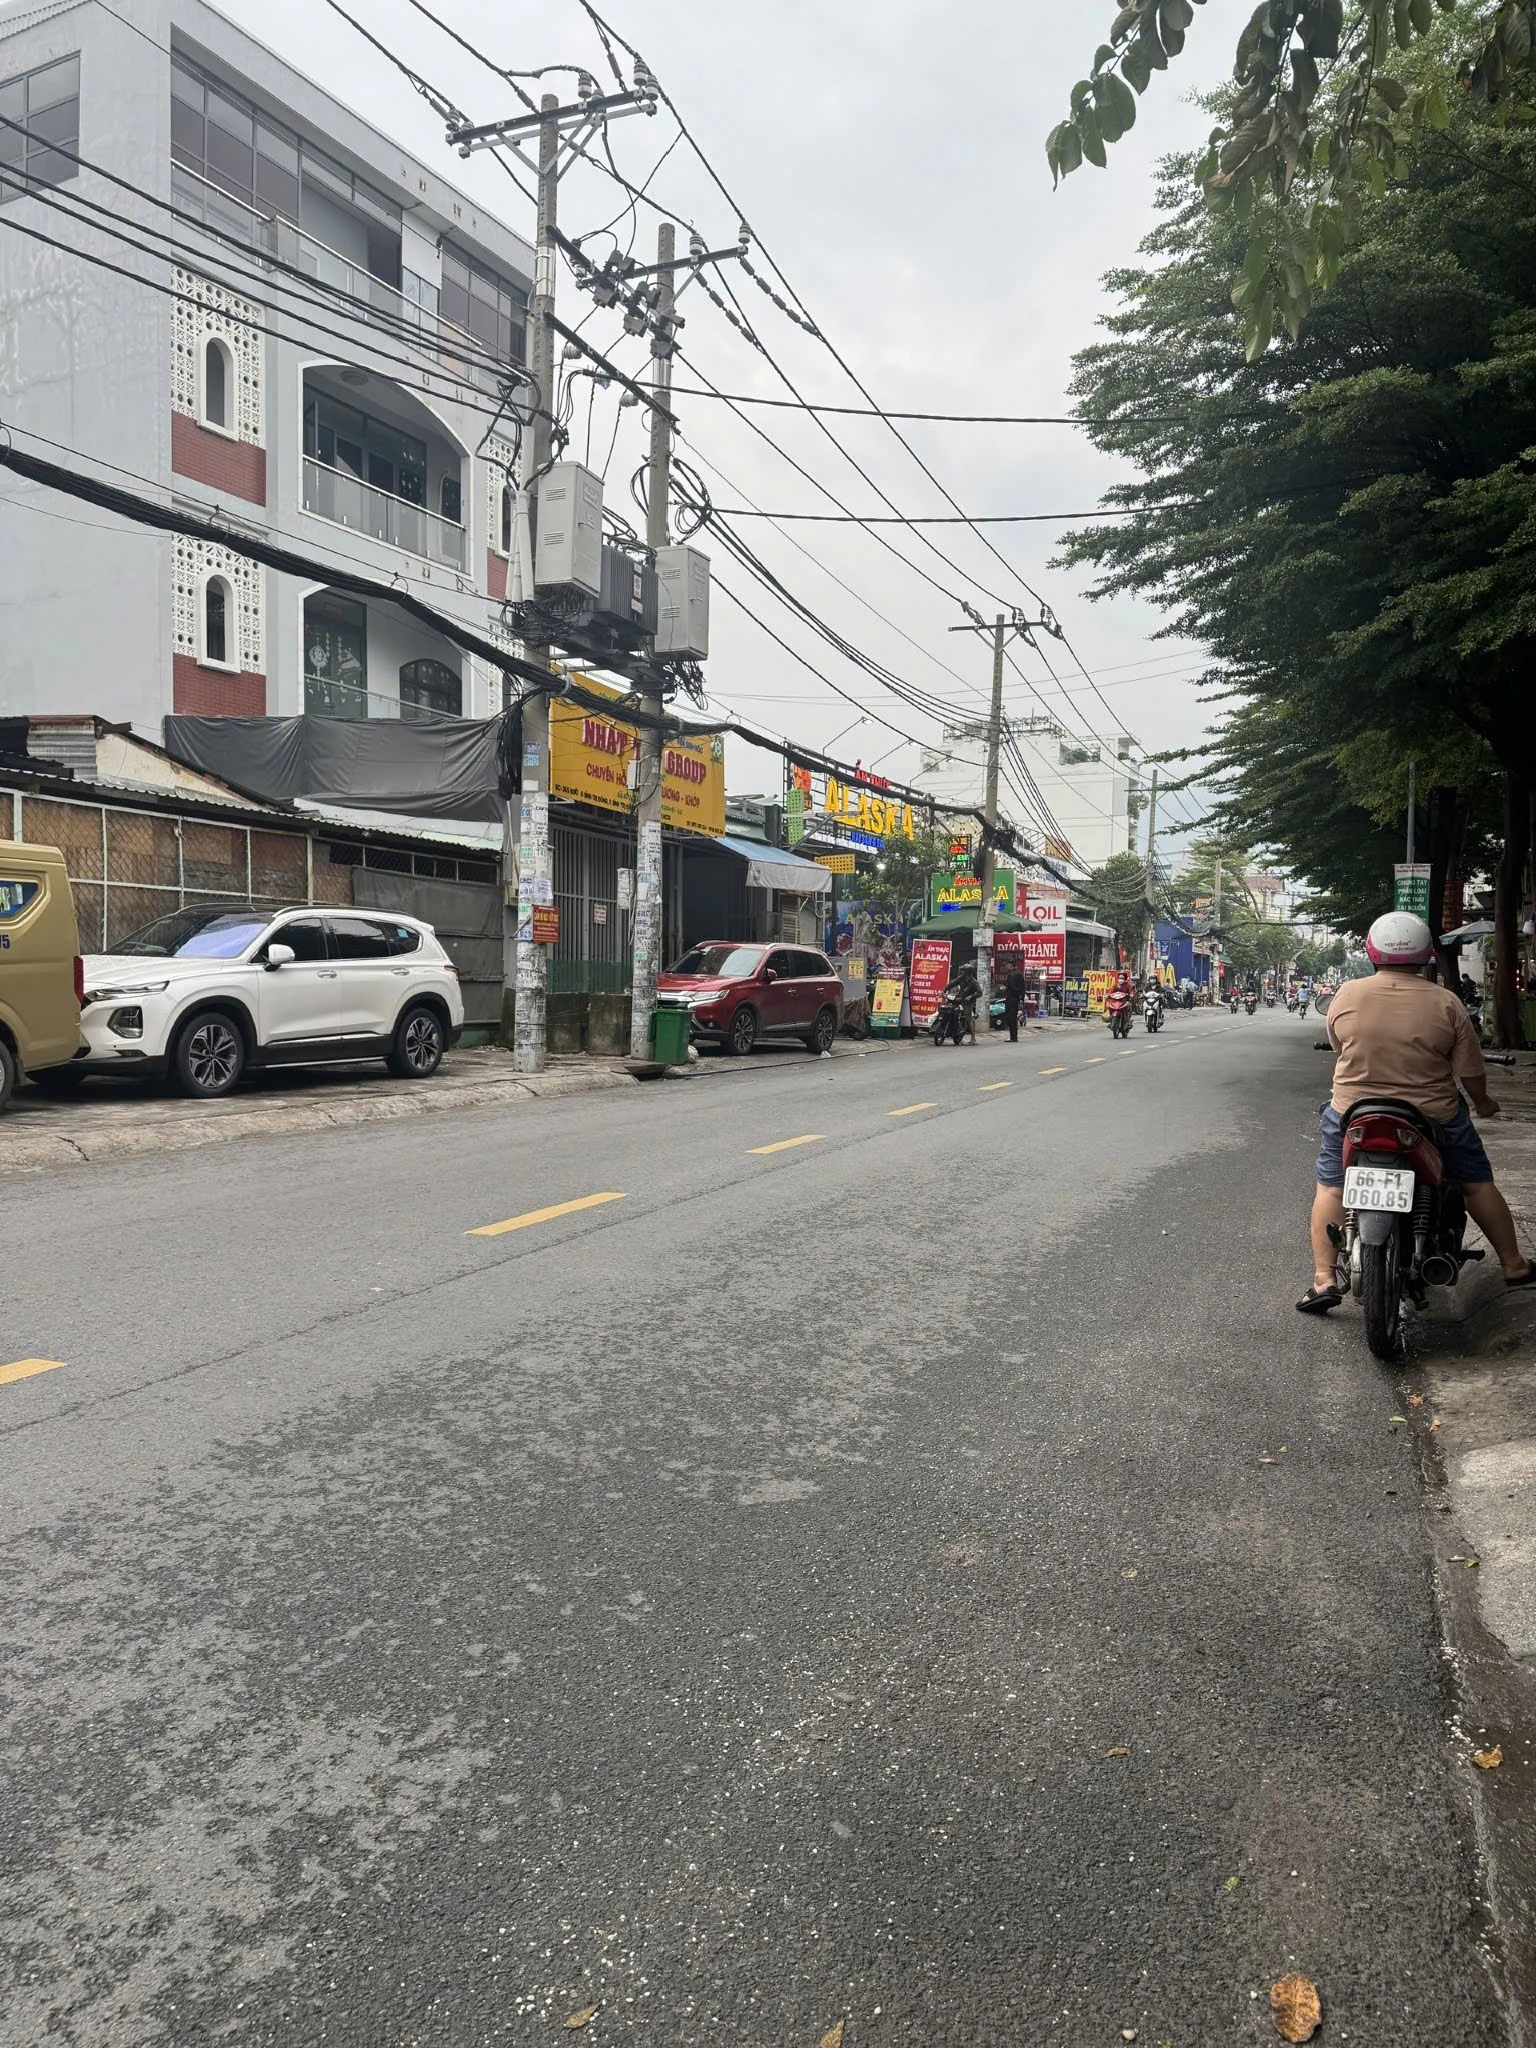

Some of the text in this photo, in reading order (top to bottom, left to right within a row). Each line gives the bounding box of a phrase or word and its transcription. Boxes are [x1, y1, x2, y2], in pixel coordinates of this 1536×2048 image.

[586, 762, 614, 784] CHUYÊN
[664, 750, 707, 784] GROUP
[824, 775, 915, 842] ALASKA
[937, 885, 1009, 902] ALASA
[1033, 906, 1062, 921] OIL
[915, 953, 949, 962] ALASKA
[1020, 939, 1059, 958] THÀNH
[1356, 1170, 1401, 1190] 66-F1
[1347, 1188, 1409, 1208] 060.85
